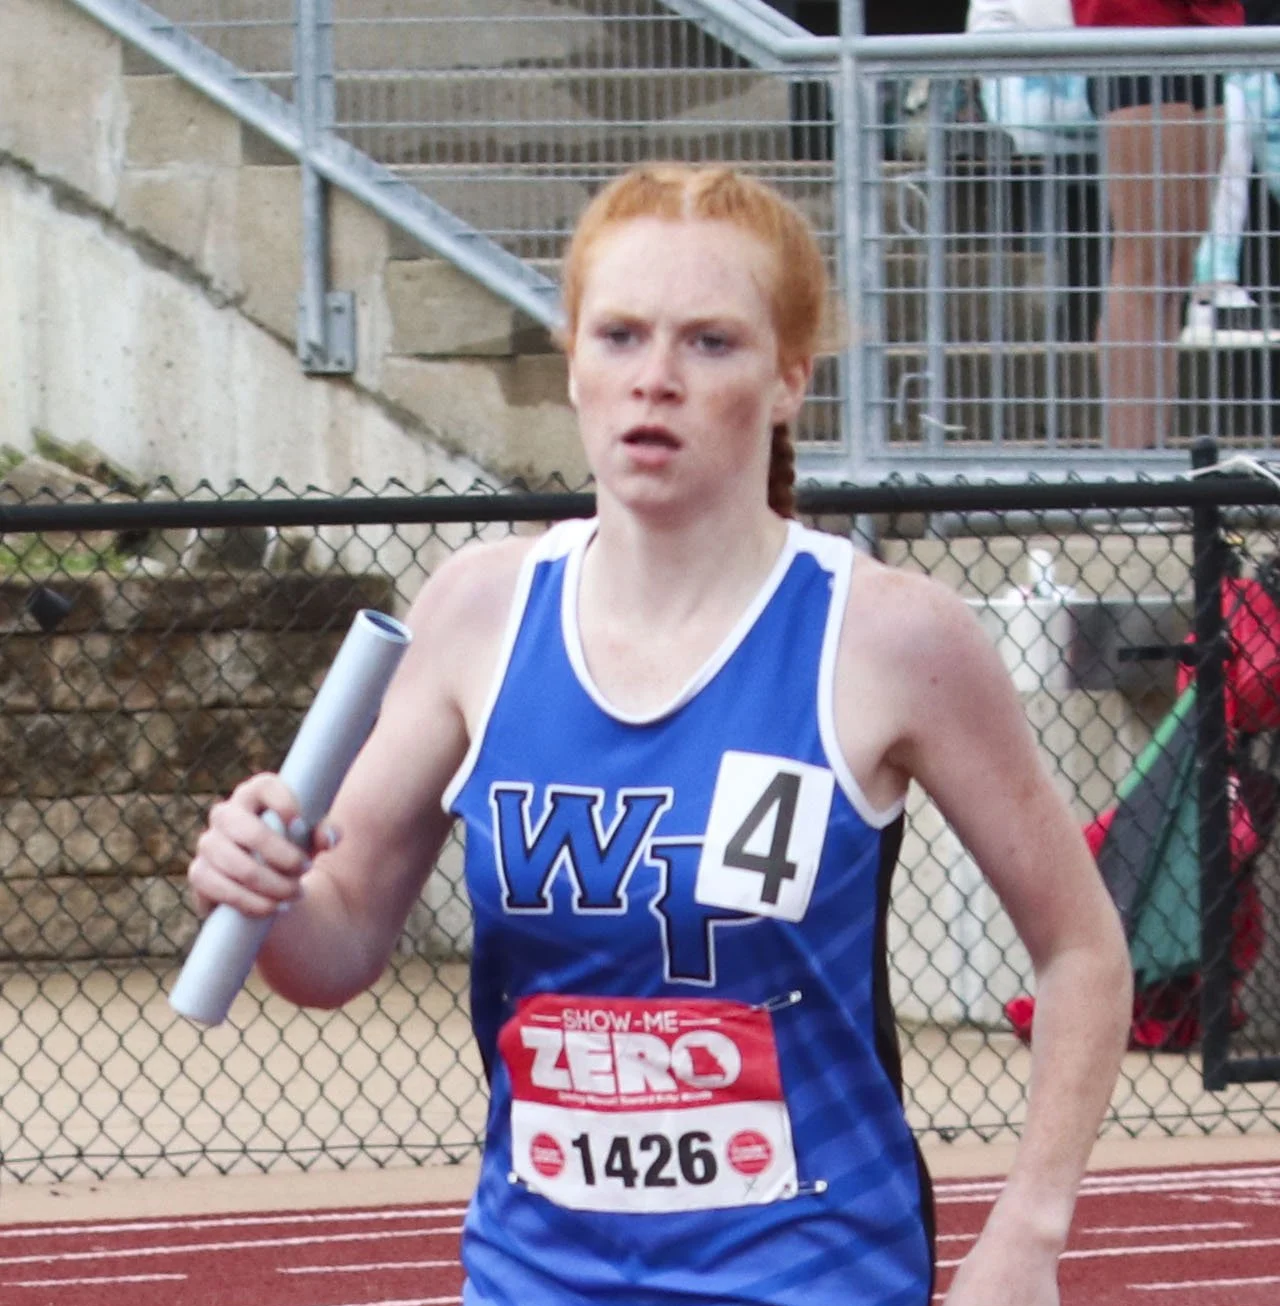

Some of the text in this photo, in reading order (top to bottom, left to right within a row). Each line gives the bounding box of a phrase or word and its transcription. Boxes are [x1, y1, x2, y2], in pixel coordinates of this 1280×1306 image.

[722, 771, 802, 905] 4
[561, 1008, 679, 1033] SHOW-ME
[519, 1025, 742, 1095] ZERO
[572, 1131, 718, 1189] 1426
